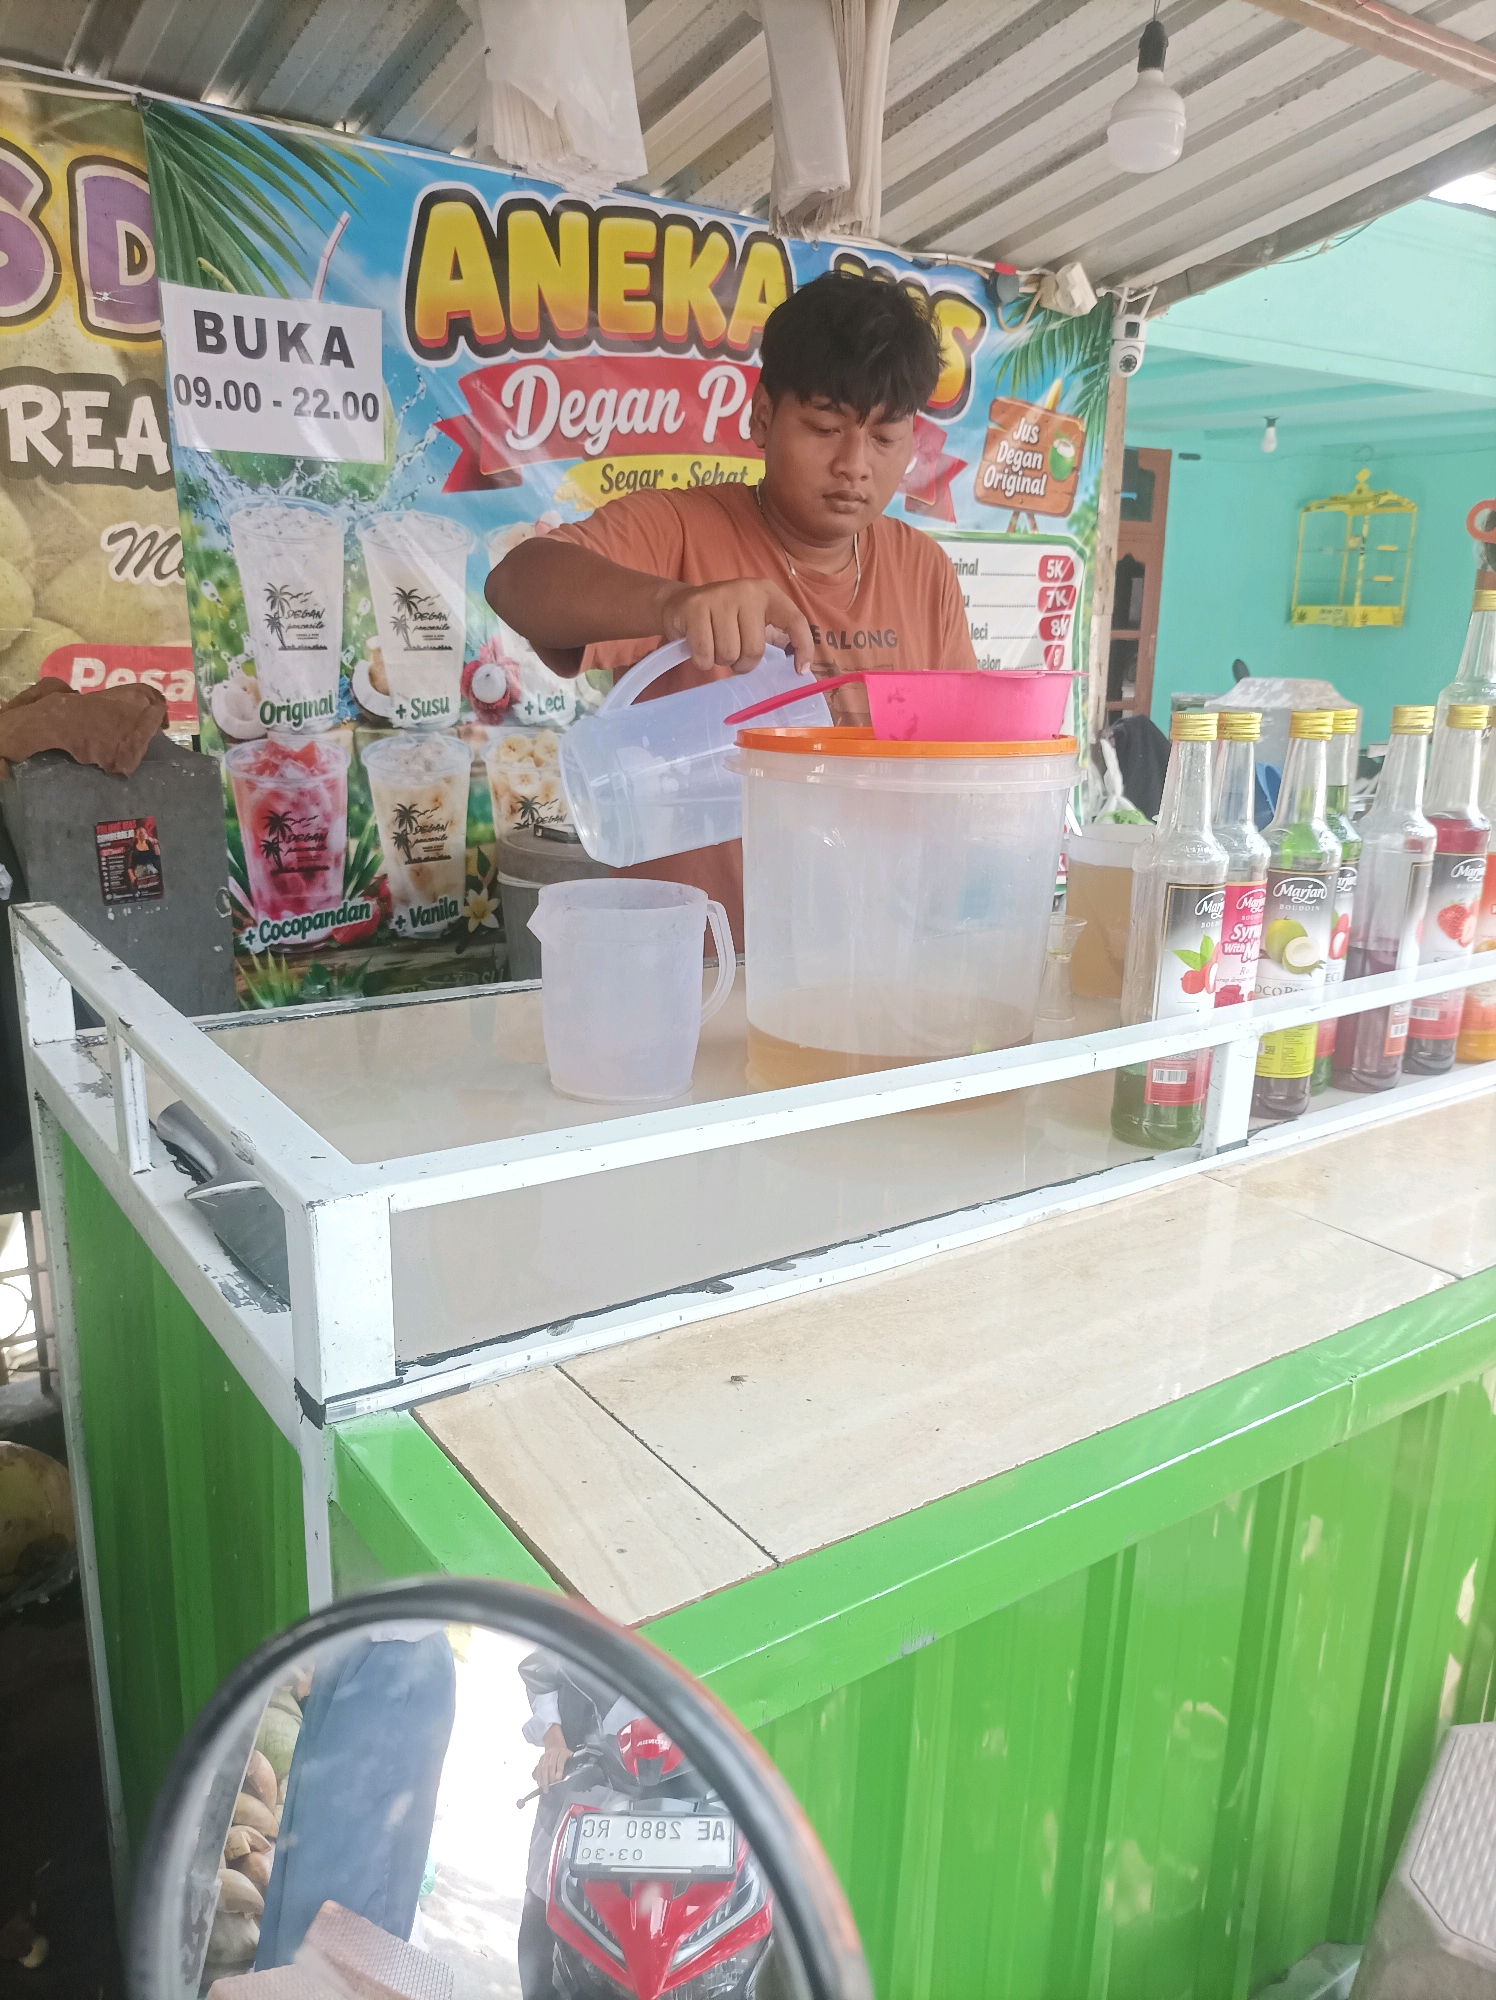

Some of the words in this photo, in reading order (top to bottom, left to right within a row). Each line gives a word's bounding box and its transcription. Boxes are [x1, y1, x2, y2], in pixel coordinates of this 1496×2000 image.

[411, 194, 792, 354] ANEKA
[194, 310, 355, 369] BUKA
[173, 374, 261, 414] 09.00
[293, 388, 380, 423] 22.00
[501, 364, 685, 456] Degan
[1012, 417, 1040, 443] Jus
[996, 441, 1044, 472] Degan
[600, 463, 664, 495] Segar
[983, 465, 1048, 498] Original
[1046, 559, 1064, 579] 5K
[286, 608, 326, 620] DEGAN
[1046, 589, 1068, 609] 7K
[826, 629, 898, 650] ALONG
[970, 622, 988, 641] leci
[260, 690, 334, 727] Original
[411, 696, 450, 720] Susu
[537, 689, 566, 716] Leci
[1276, 880, 1326, 904] Marjan
[259, 900, 371, 944] Cocopandan
[410, 897, 459, 928] Vanila
